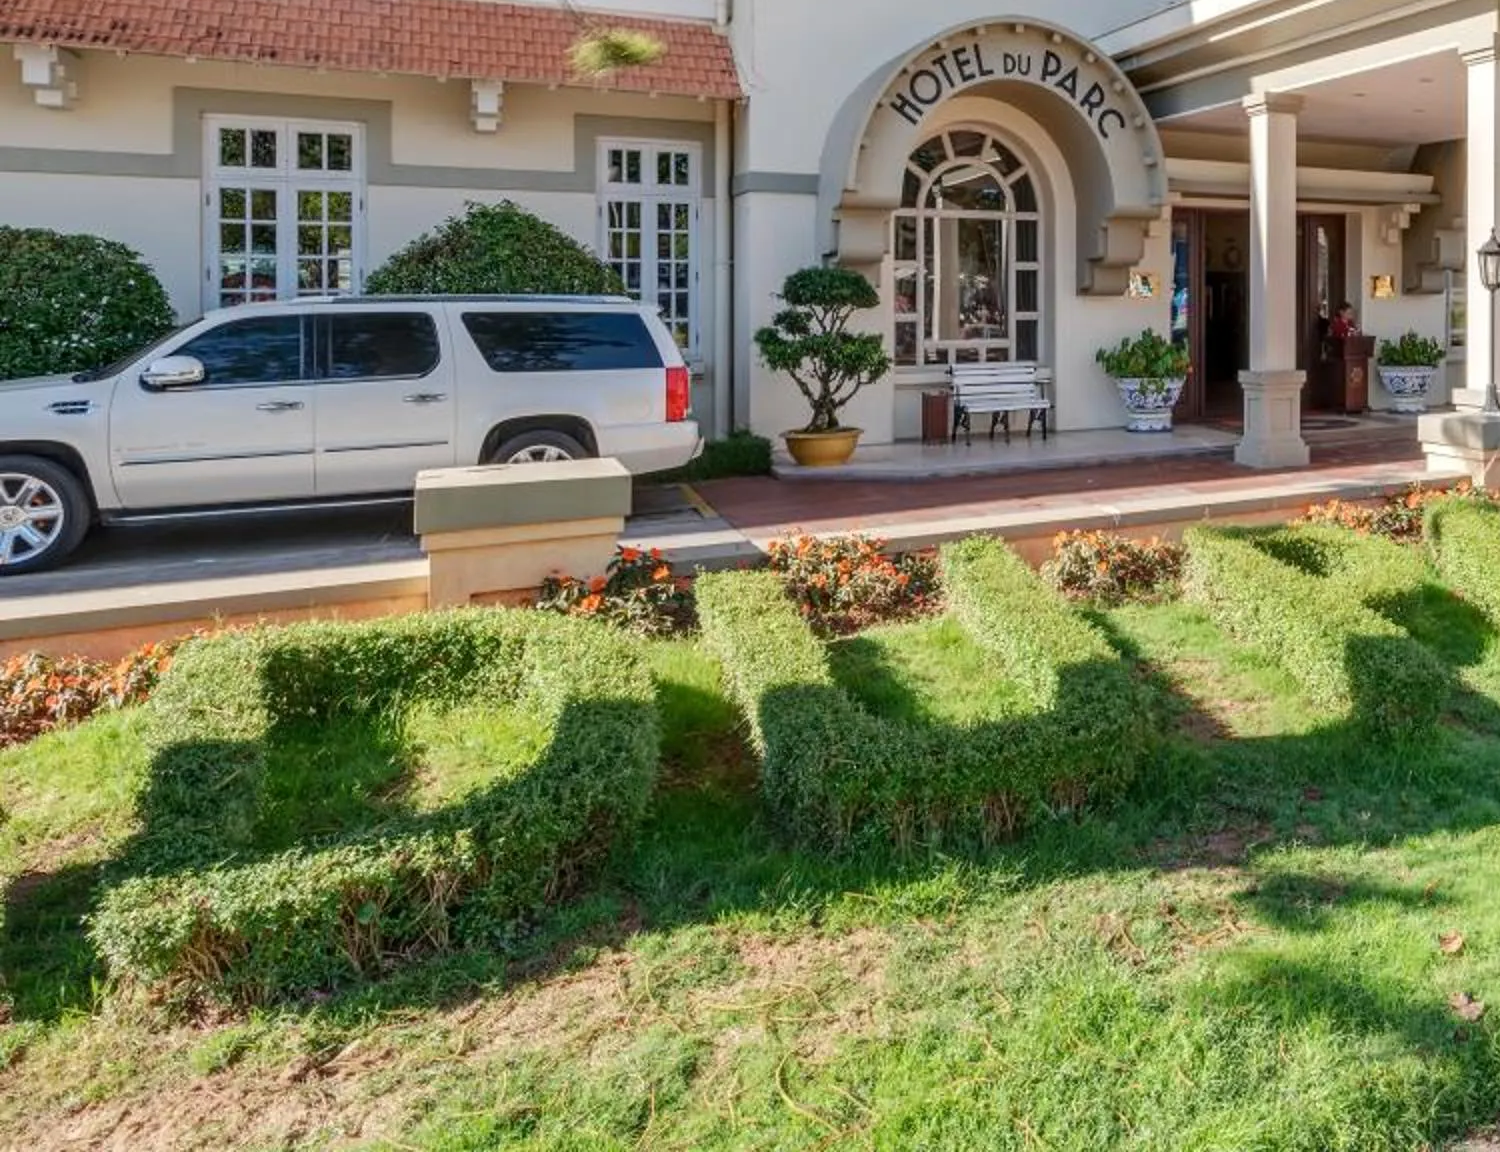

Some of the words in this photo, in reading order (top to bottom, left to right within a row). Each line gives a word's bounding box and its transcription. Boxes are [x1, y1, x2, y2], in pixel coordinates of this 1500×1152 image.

[890, 43, 994, 126] HOTEL
[1003, 53, 1031, 77] DU
[1041, 49, 1126, 139] PARC
